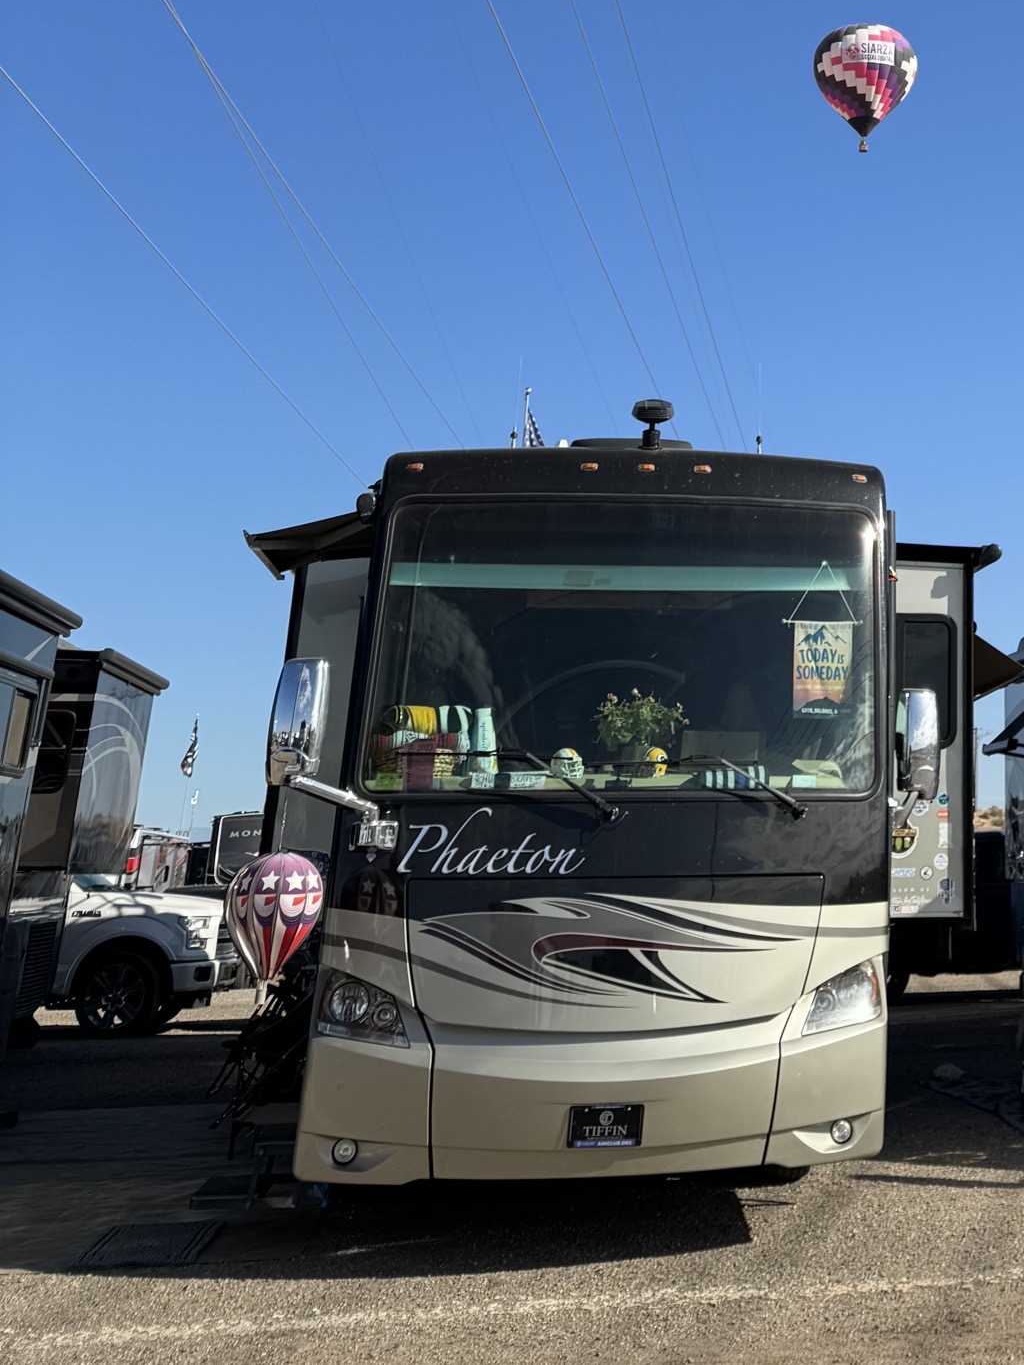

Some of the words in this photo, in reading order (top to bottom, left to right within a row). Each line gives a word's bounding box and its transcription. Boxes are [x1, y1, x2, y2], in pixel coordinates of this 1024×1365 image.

[861, 43, 893, 55] SIARZA
[799, 648, 837, 664] TODAY
[796, 665, 849, 681] SOMEDAY
[396, 807, 586, 875] Phaeton
[583, 1125, 628, 1137] TIFFIN
